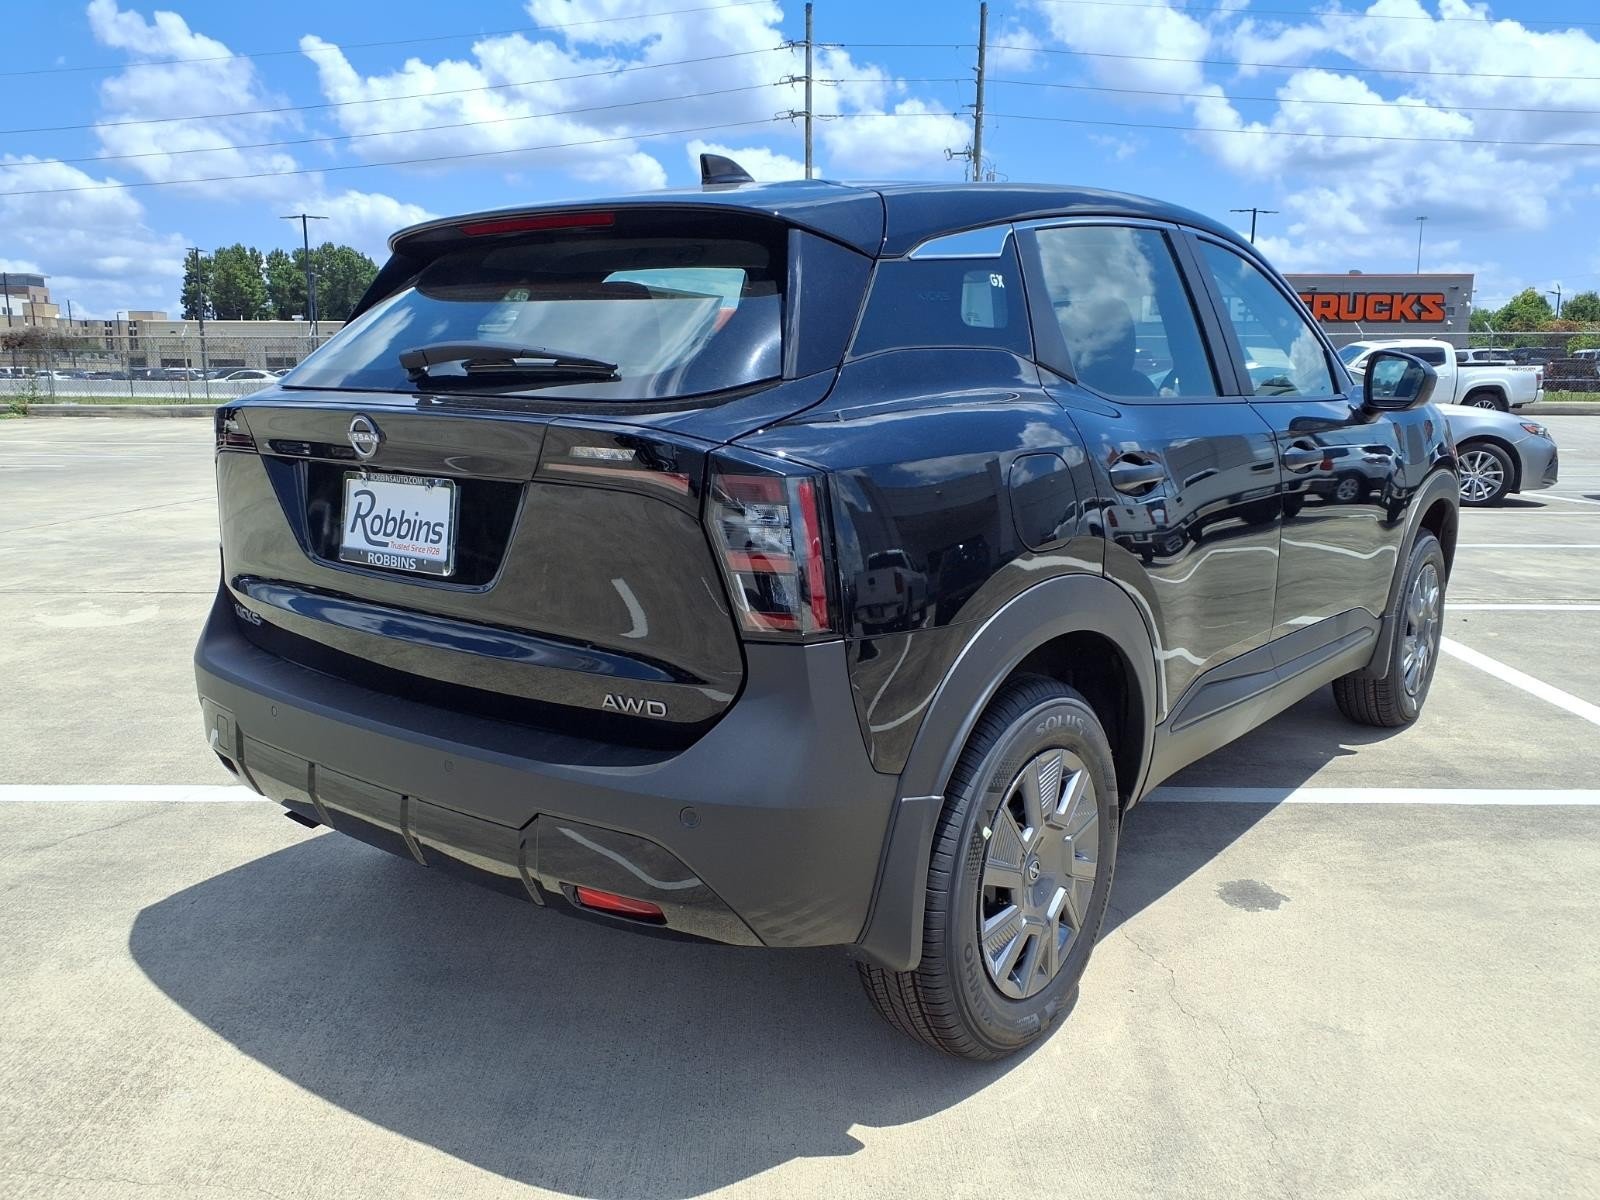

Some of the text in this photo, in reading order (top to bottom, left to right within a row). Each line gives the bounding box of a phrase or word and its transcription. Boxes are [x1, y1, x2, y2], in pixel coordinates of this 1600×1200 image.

[350, 489, 445, 548] Robbins
[390, 541, 440, 556] Trusted Since 1928
[367, 552, 416, 570] ROBBINS
[602, 694, 667, 717] AWD
[1036, 714, 1085, 737] SOLUS
